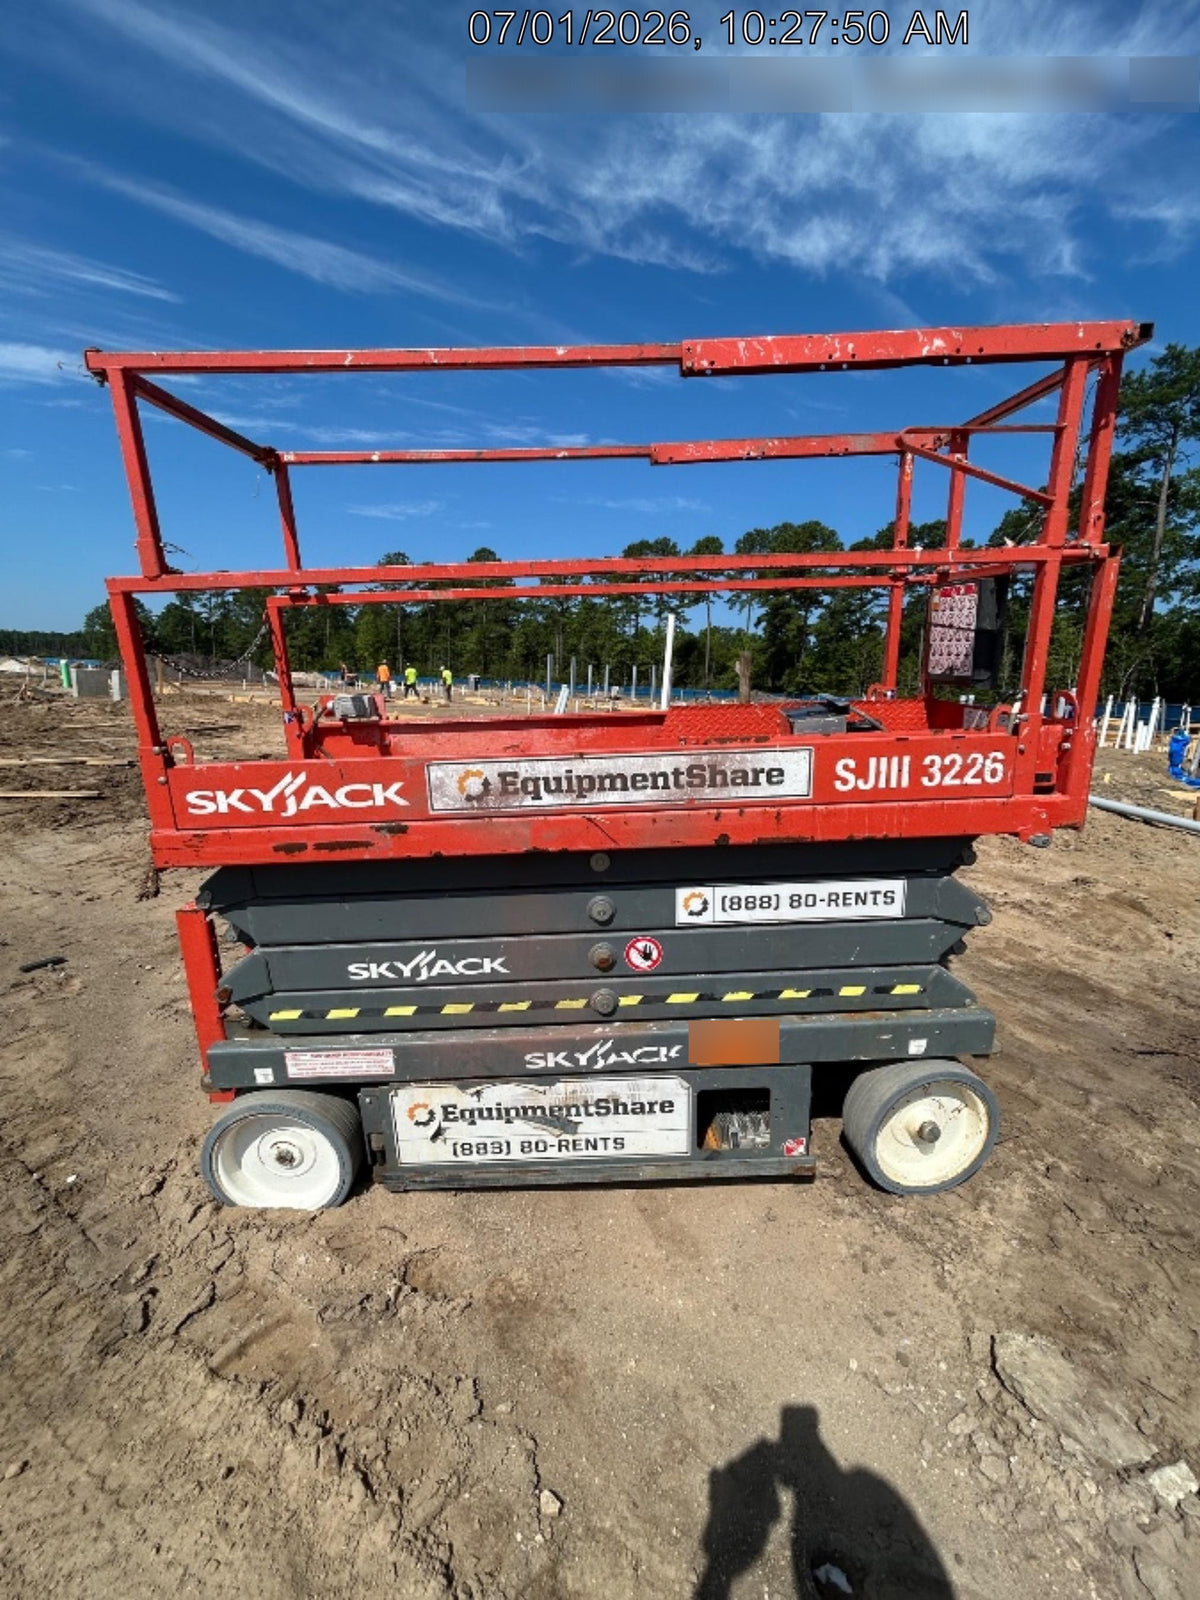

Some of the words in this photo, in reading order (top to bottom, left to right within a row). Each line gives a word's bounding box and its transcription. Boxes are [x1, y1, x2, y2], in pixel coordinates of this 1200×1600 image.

[498, 765, 785, 799] EquipmentShare
[920, 751, 1006, 787] 3226
[185, 771, 410, 817] SKYJACK
[721, 893, 780, 912] (888)
[788, 889, 896, 909] 80-RENTS
[347, 949, 510, 982] SKYJACK
[440, 1098, 675, 1126] EquipmentShare
[520, 1137, 626, 1154] 80-RENTS
